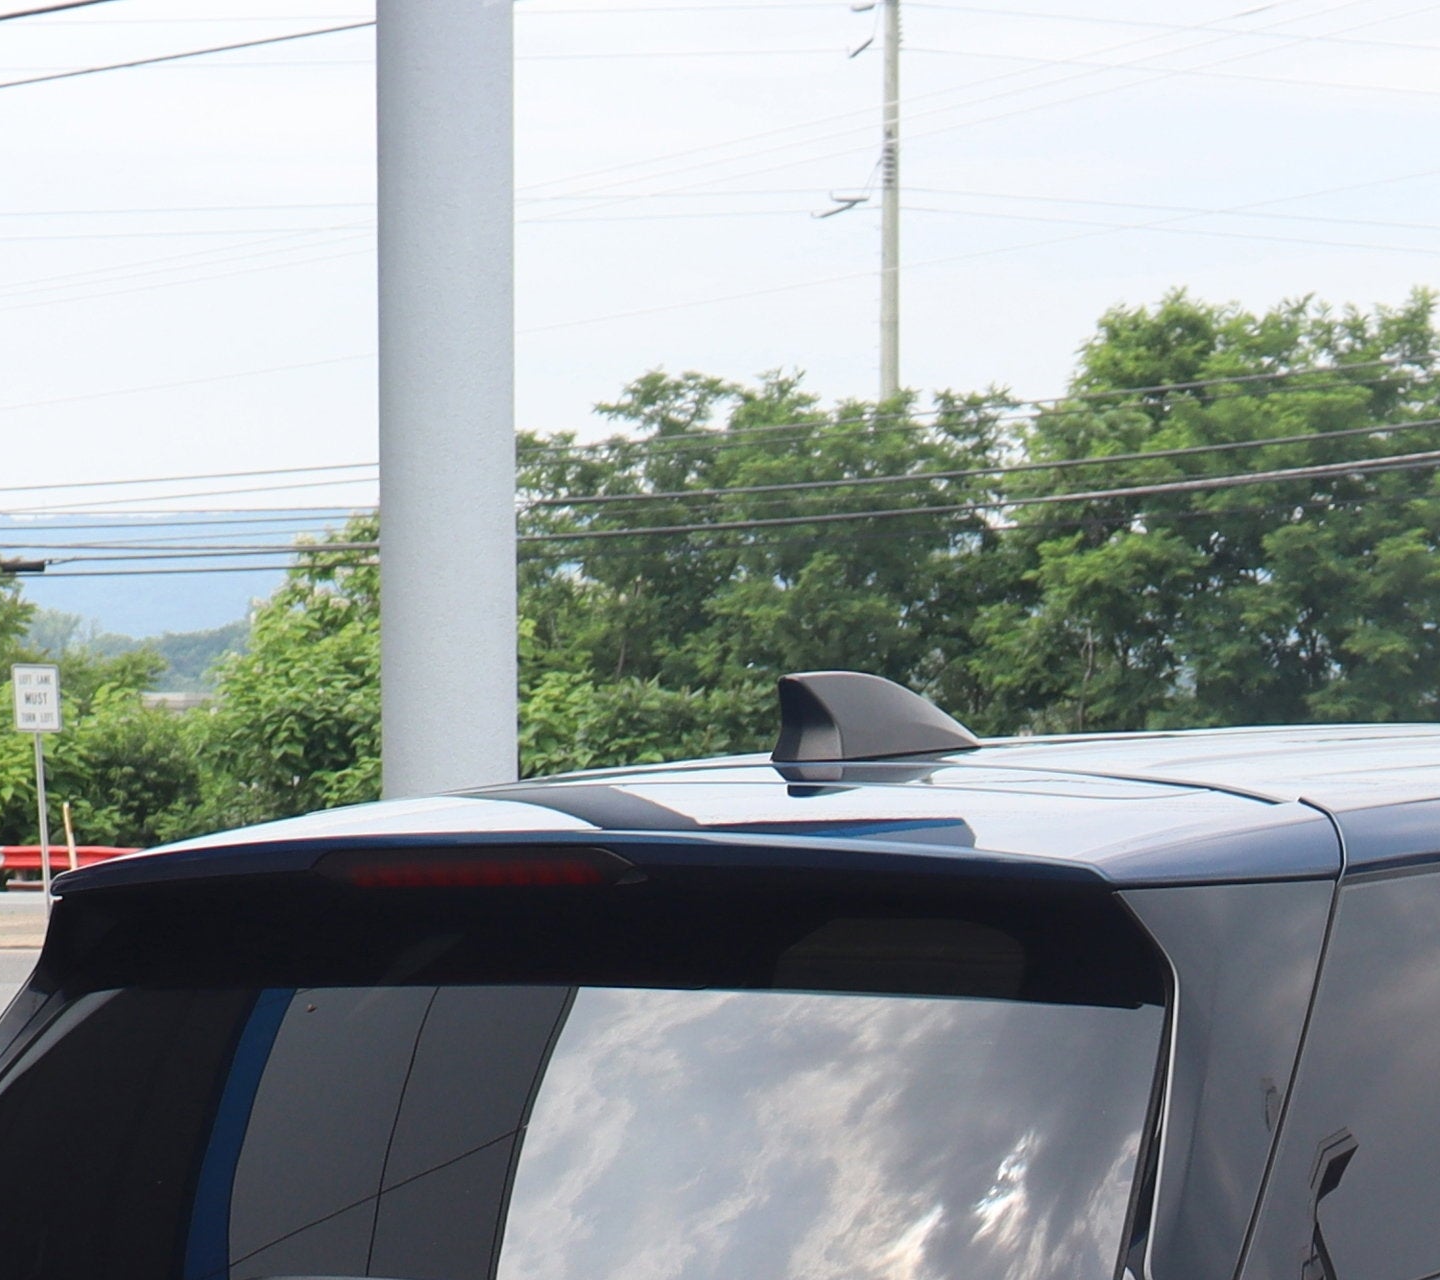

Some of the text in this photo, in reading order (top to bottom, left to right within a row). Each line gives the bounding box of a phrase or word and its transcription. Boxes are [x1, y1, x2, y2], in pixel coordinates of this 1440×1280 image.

[18, 674, 51, 685] LEFT LANE
[24, 691, 48, 705] MUST
